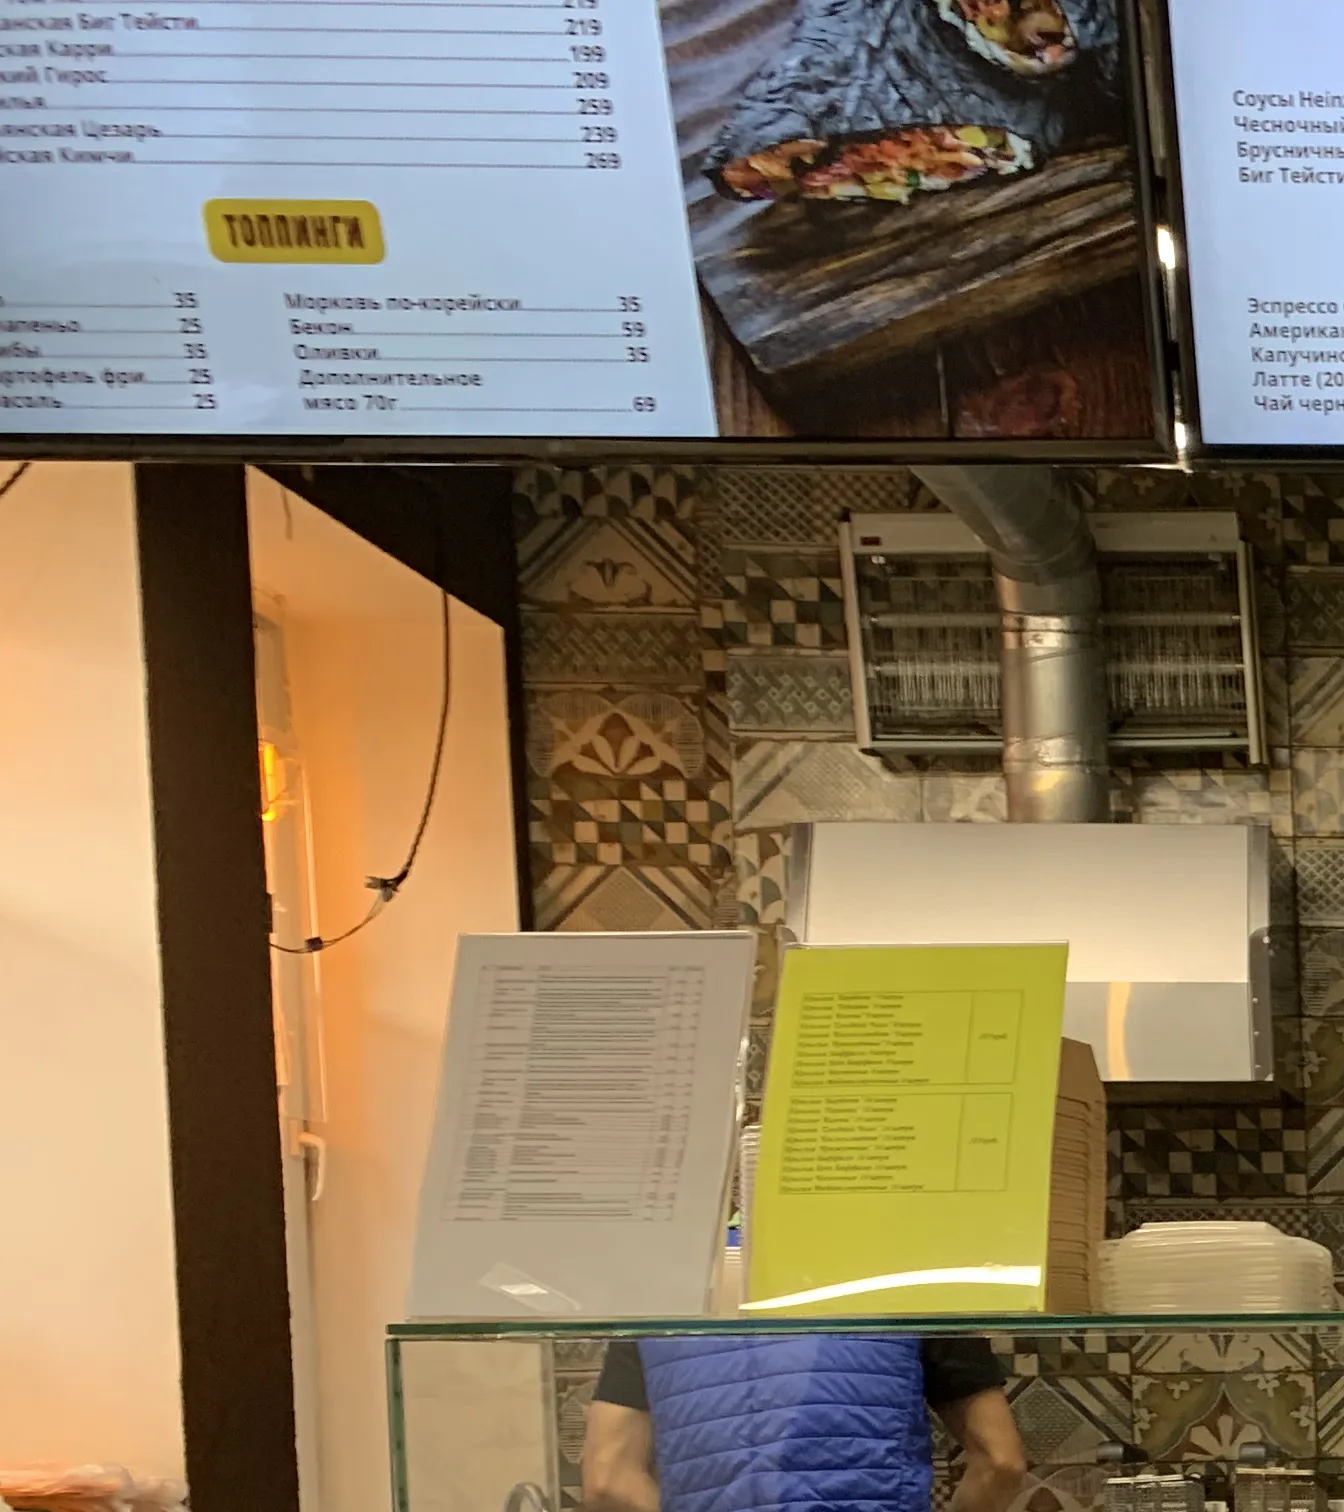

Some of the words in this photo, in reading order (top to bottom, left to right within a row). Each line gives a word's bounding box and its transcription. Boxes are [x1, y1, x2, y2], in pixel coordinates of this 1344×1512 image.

[569, 45, 606, 64] 199
[571, 72, 610, 90] 209
[1233, 90, 1294, 110] Соусы
[80, 120, 164, 142] Цезарь
[580, 126, 618, 144] 239
[1239, 167, 1275, 185] Биг
[223, 213, 368, 251] ТОППИНГИ
[285, 293, 381, 314] Морковь
[385, 294, 522, 314] по-корейски
[1248, 298, 1338, 319] Эспрессо
[289, 318, 354, 336] Бекон
[621, 321, 646, 338] 59
[294, 343, 381, 361] Оливки
[625, 346, 651, 363] 35
[299, 369, 484, 388] Дополнительное
[1253, 371, 1312, 390] Латте
[1254, 395, 1294, 412] Чай
